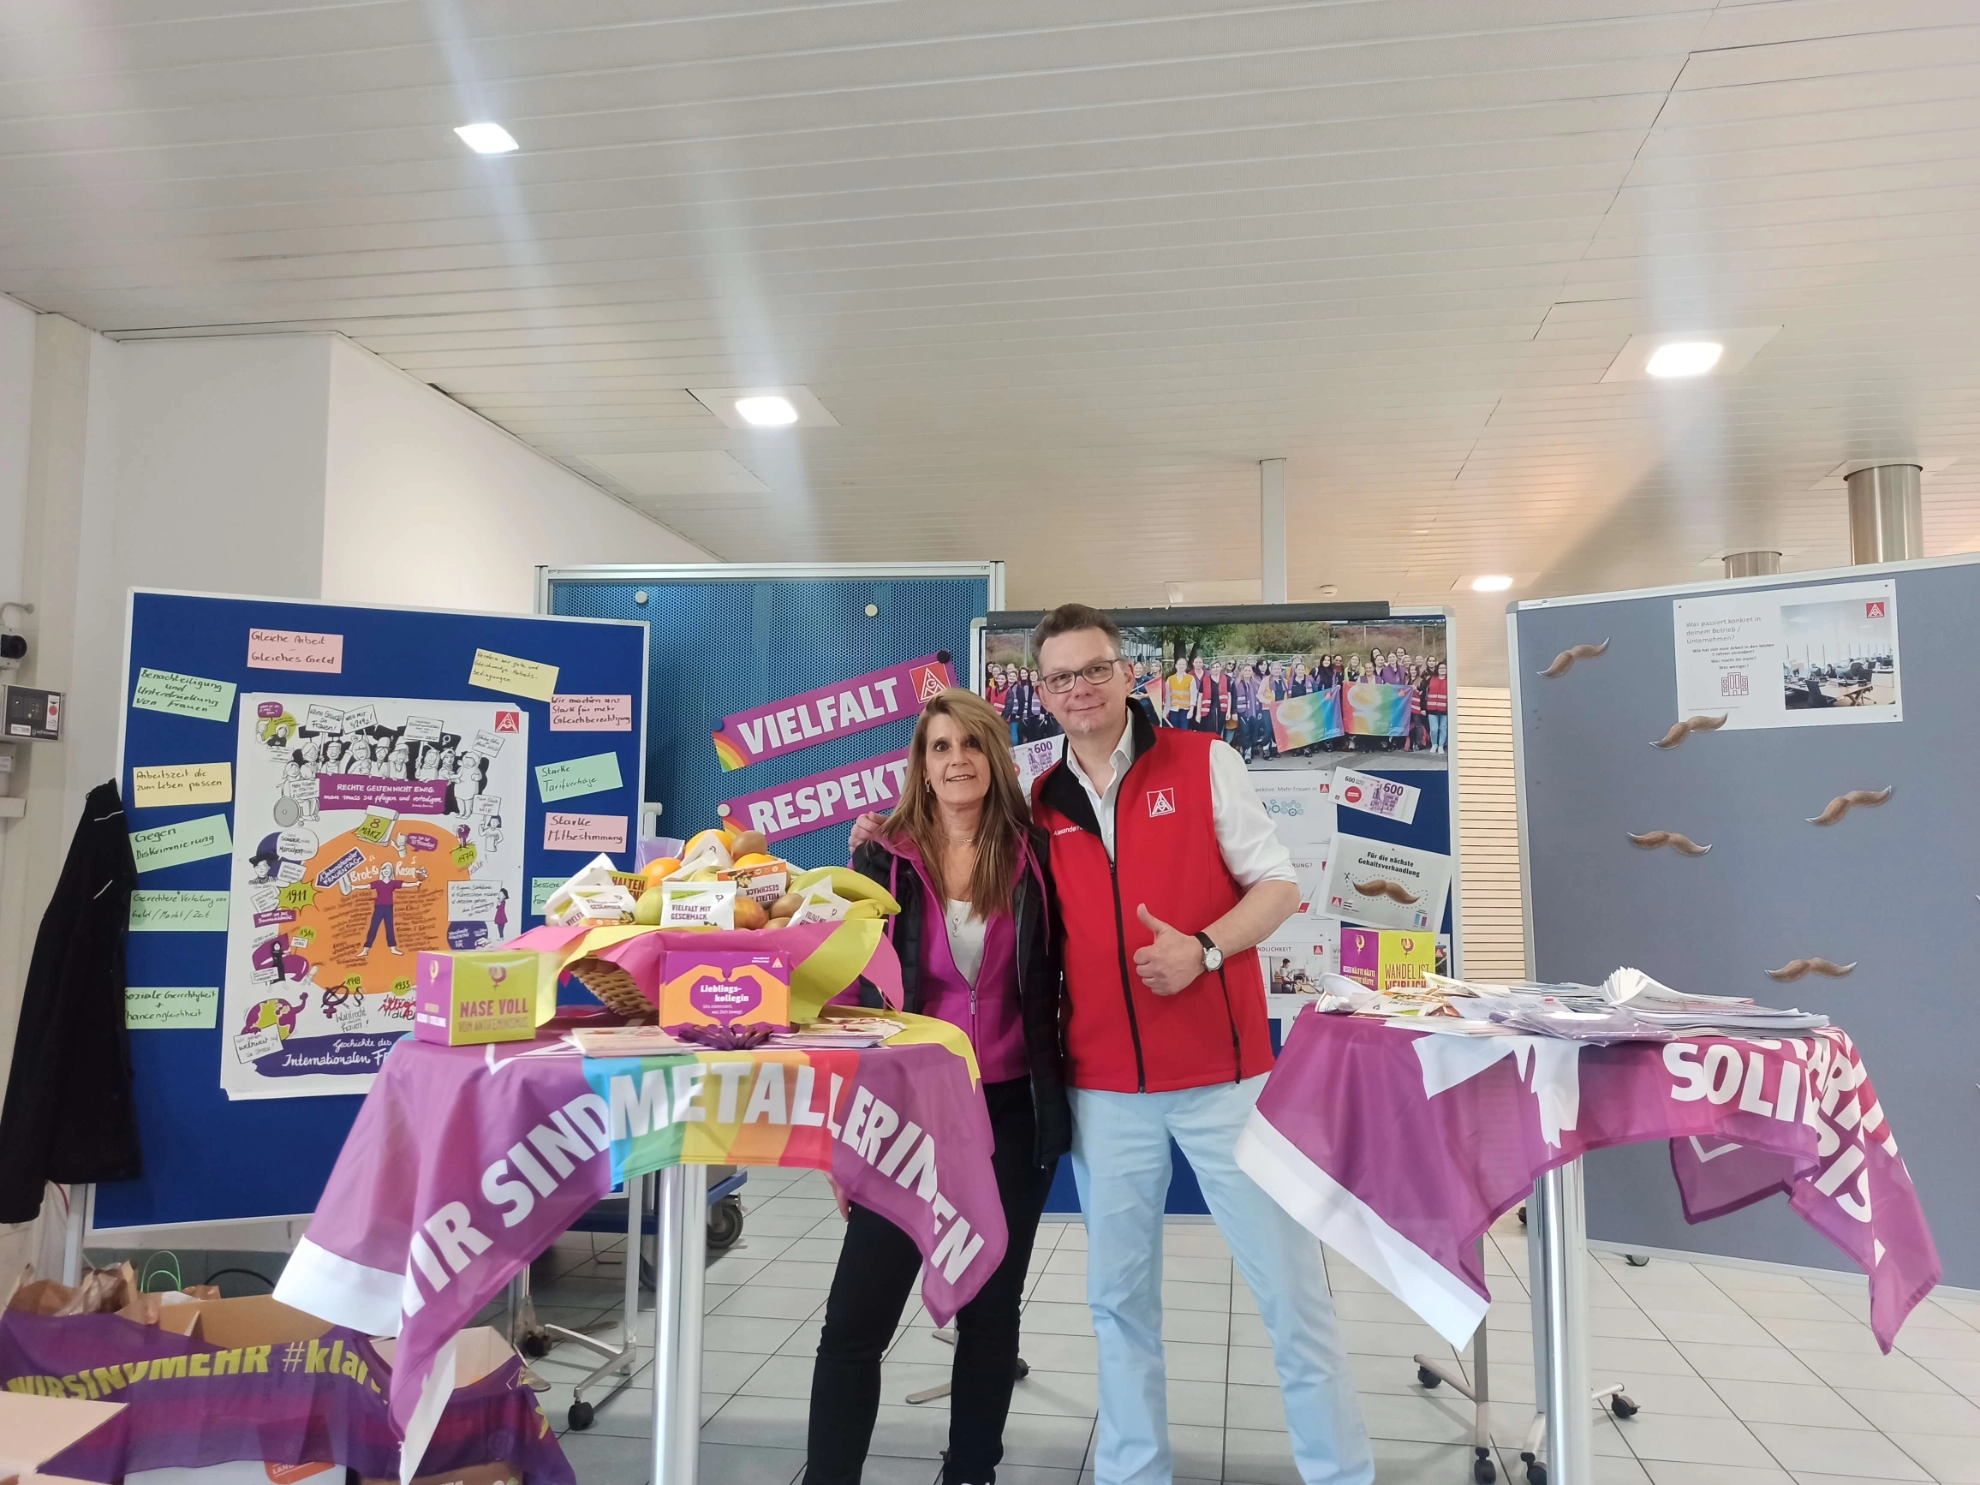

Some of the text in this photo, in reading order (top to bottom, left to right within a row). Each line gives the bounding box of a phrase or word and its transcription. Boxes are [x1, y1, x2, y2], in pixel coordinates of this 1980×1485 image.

[1701, 619, 1727, 627] passiert
[1728, 616, 1754, 624] konkret
[294, 635, 325, 645] Arbeit
[1686, 635, 1735, 644] Unternehmen?
[251, 652, 302, 663] Gleiches
[165, 683, 187, 692] und
[737, 677, 899, 755] VIELFALT
[1034, 741, 1053, 754] 600
[336, 783, 365, 792] RECHTE
[366, 784, 393, 792] GELTEN
[1383, 783, 1405, 797] 600
[748, 758, 909, 836] RESPEKT
[369, 818, 381, 829] 8
[134, 827, 177, 843] Gegen
[1367, 852, 1378, 860] Für
[1389, 857, 1415, 868] nächste
[1358, 858, 1421, 878] Gehaltsverhandlung
[285, 889, 307, 904] 1911
[671, 904, 712, 912] VIELFALT MIT
[670, 913, 708, 921] GESCHMACK
[1384, 963, 1416, 980] WANDEL
[700, 984, 742, 994] Lieblings-
[714, 994, 749, 1004] kollegin
[460, 997, 529, 1018] NASE VOLL
[125, 1009, 202, 1023] hancengleichheit
[333, 1038, 375, 1053] Geschichte
[481, 1093, 612, 1228] SIND
